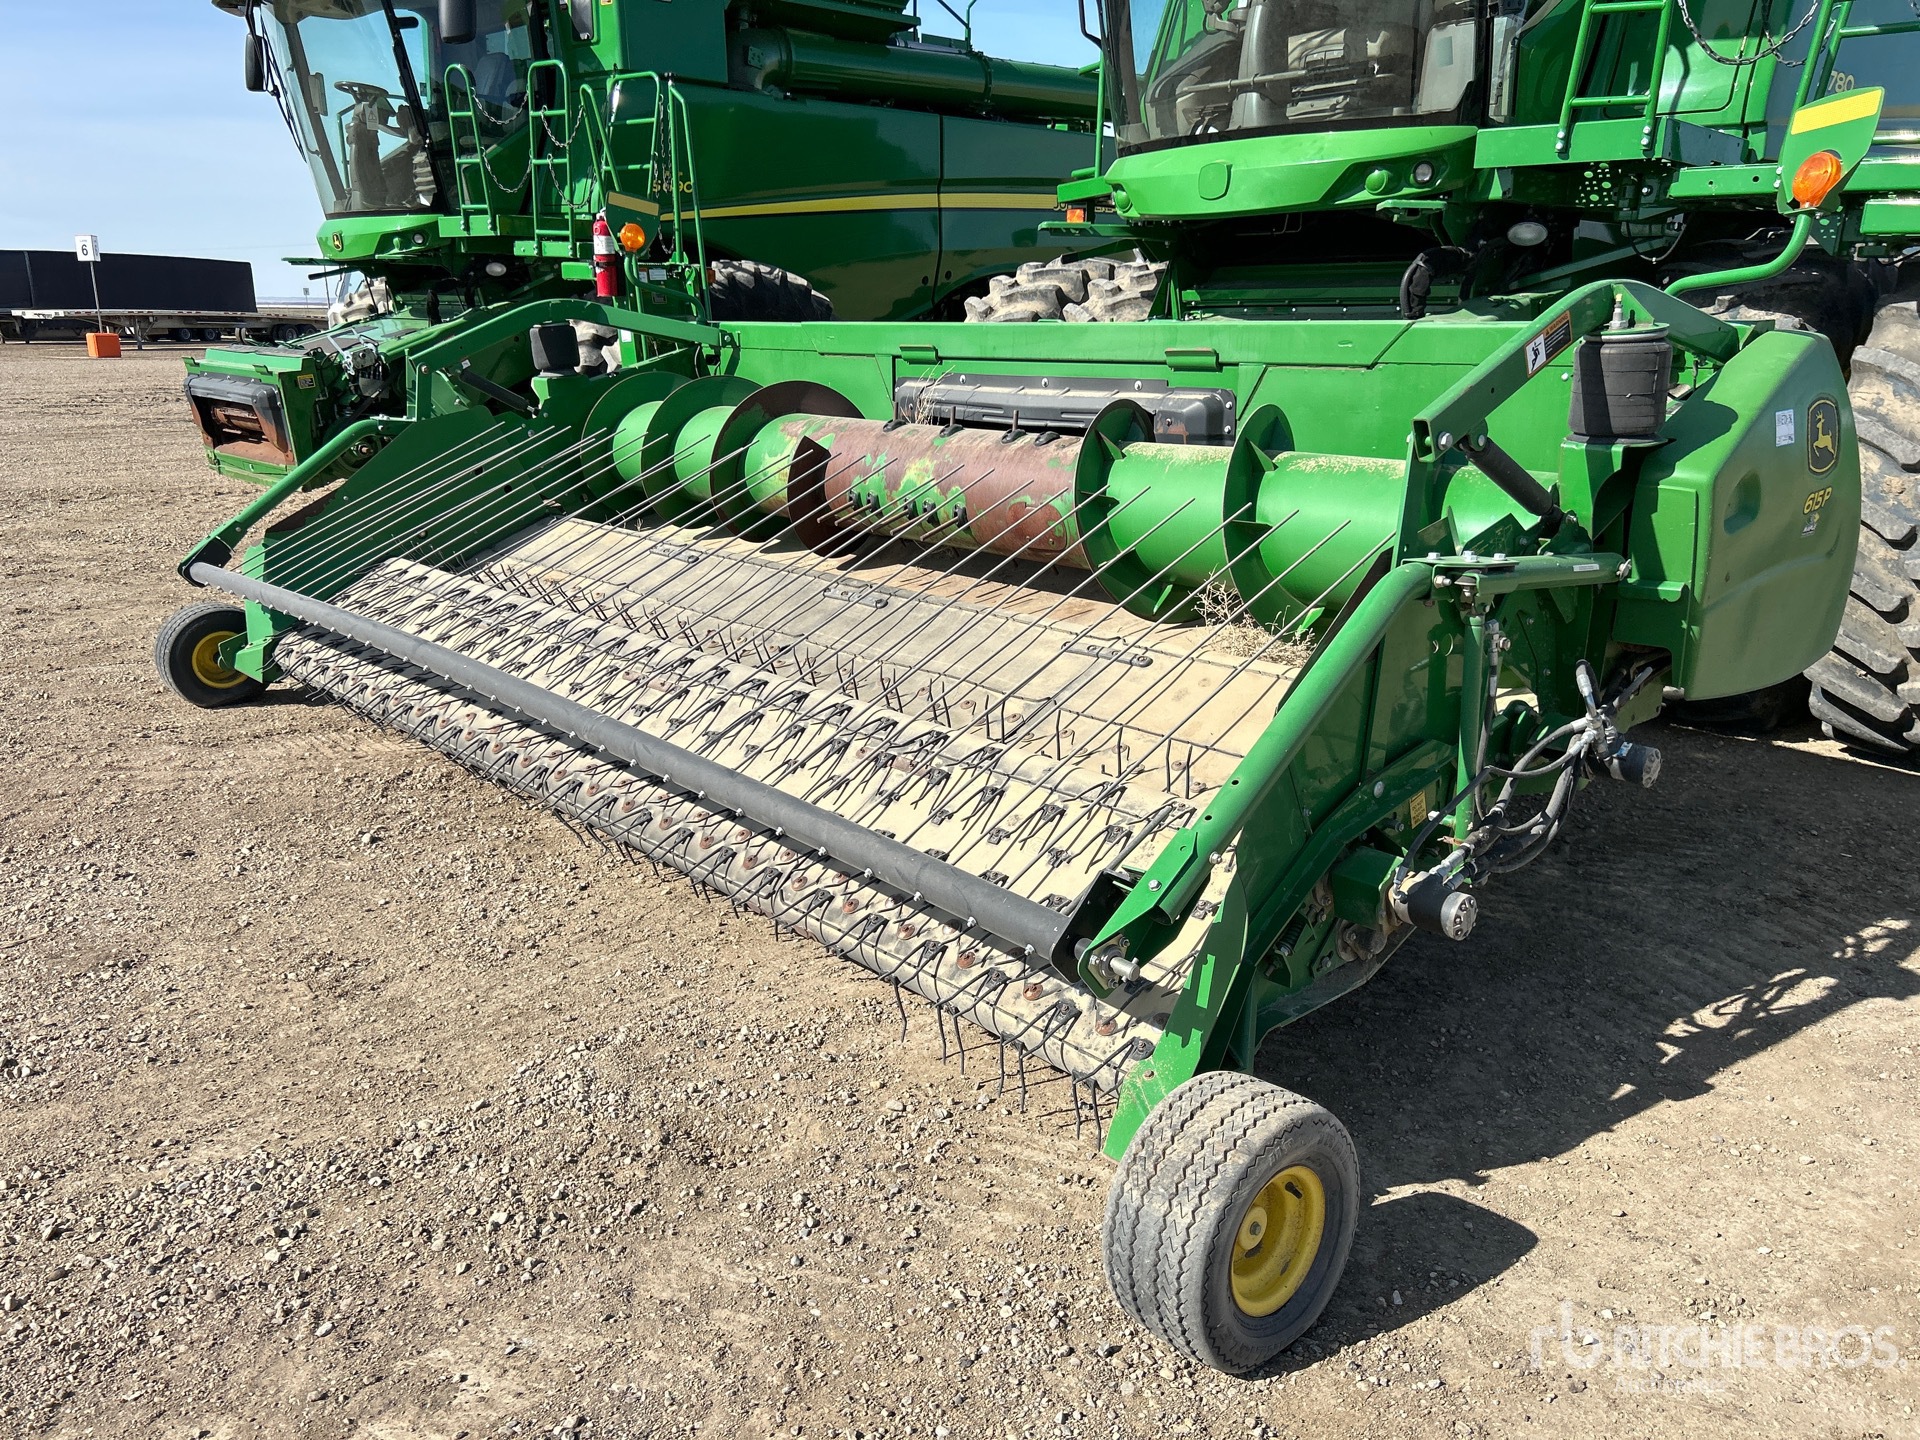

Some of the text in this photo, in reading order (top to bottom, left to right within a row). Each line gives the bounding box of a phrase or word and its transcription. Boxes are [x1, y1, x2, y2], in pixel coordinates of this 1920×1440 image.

[1827, 70, 1855, 93] 780
[81, 244, 88, 257] 6
[1549, 313, 1569, 331] WARNING
[1803, 486, 1833, 515] 615P
